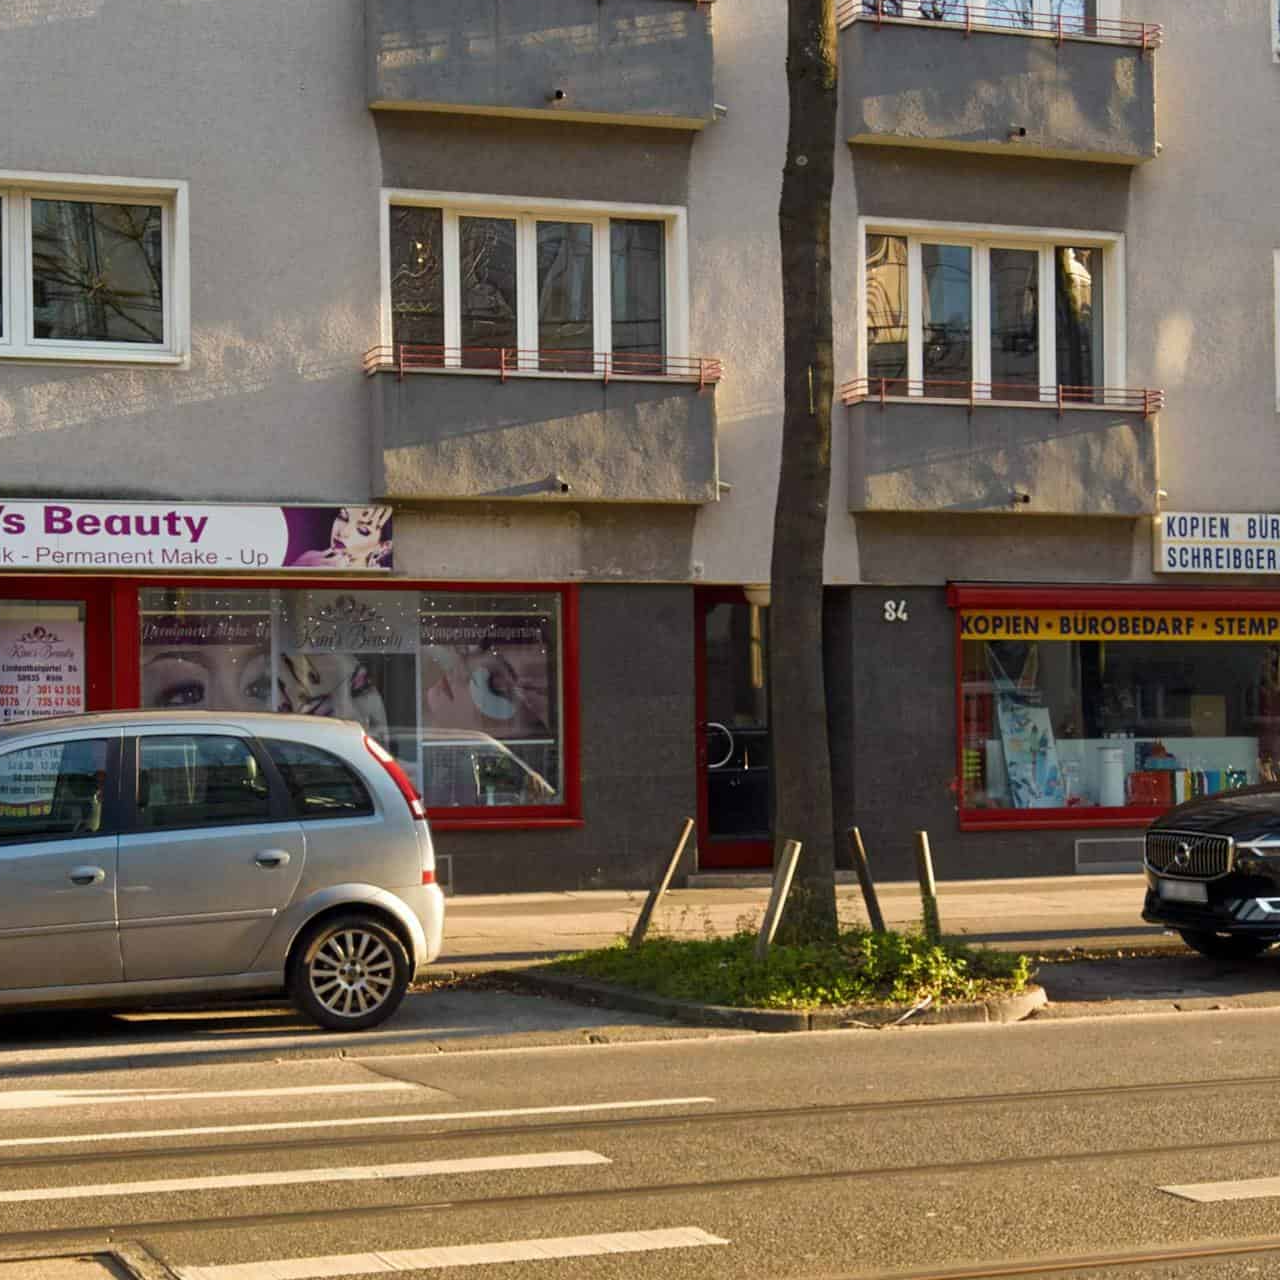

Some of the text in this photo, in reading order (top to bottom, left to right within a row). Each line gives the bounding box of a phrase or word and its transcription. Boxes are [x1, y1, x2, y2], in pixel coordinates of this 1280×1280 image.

[43, 505, 209, 544] Beauty
[1167, 516, 1230, 539] KOPIEN
[35, 546, 155, 565] Permanent
[161, 548, 219, 565] Make
[239, 549, 269, 568] Up
[884, 599, 908, 621] 84
[960, 616, 1040, 635] KOPIEN
[1059, 613, 1195, 636] BÜROBEDARF
